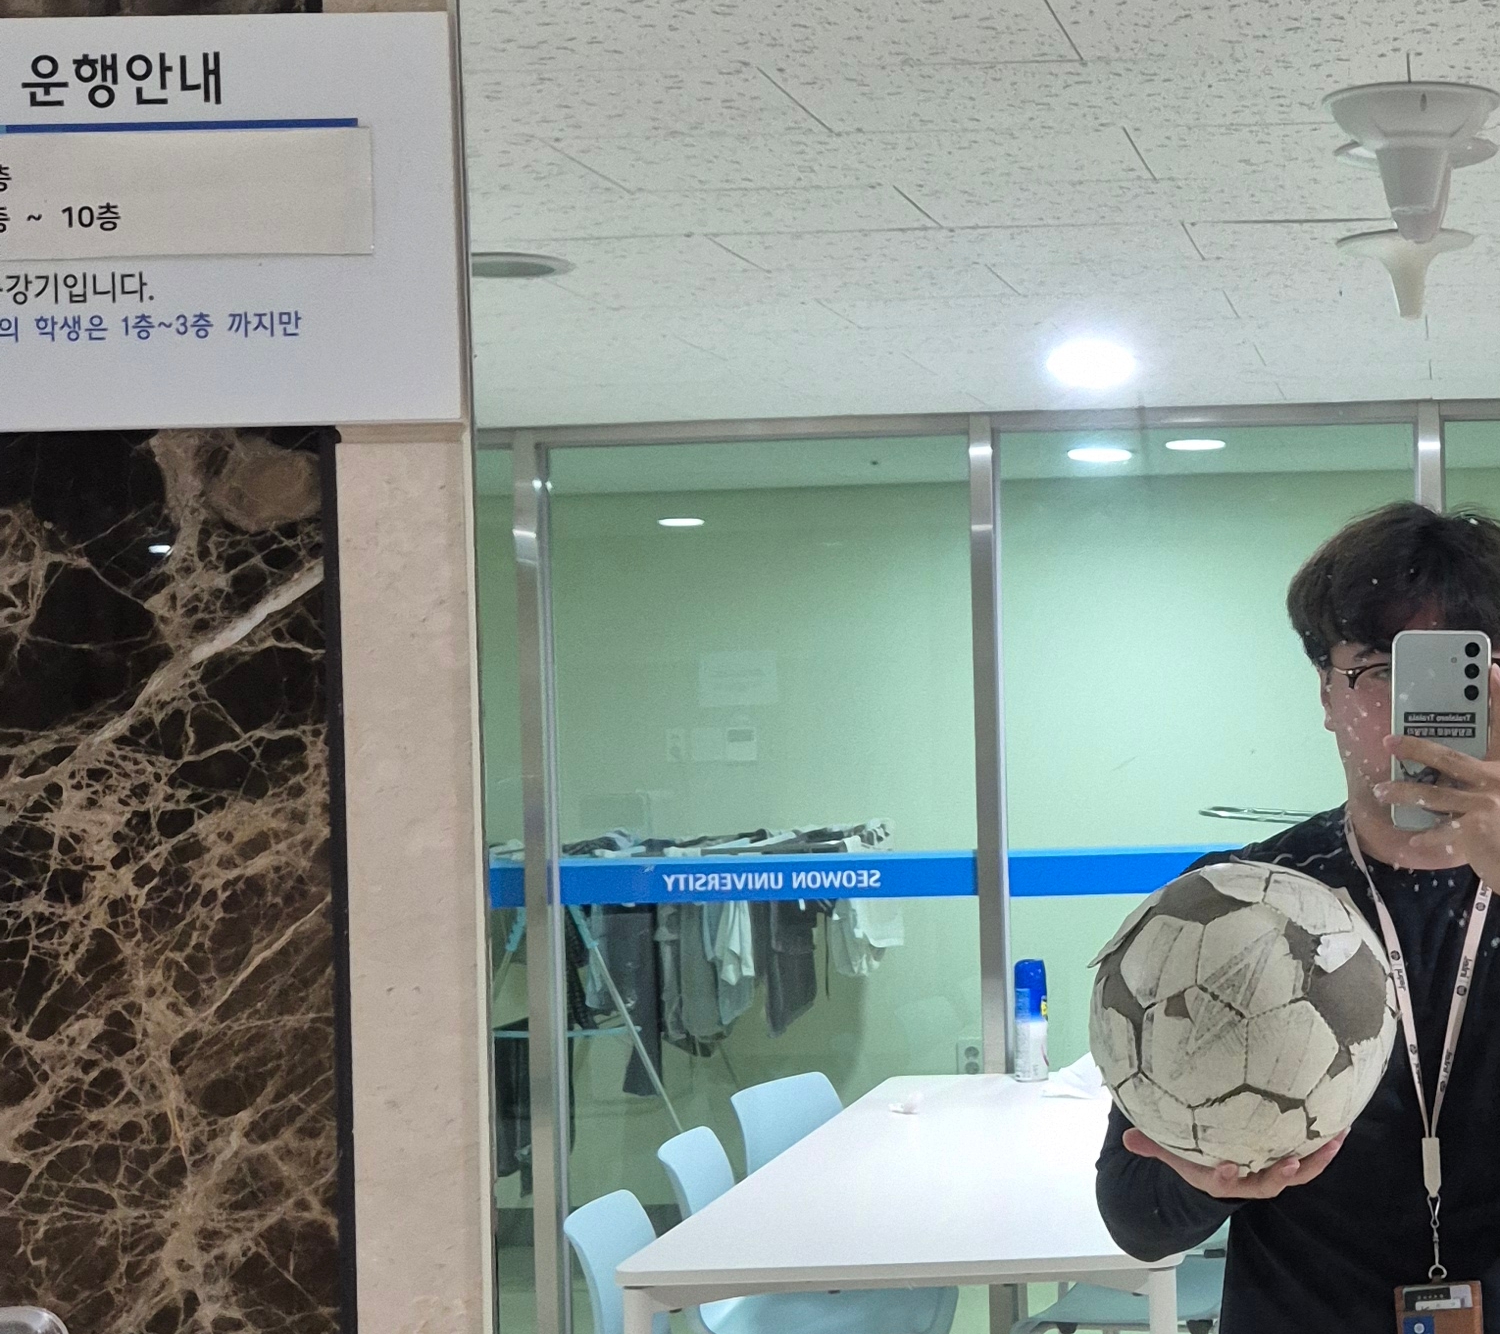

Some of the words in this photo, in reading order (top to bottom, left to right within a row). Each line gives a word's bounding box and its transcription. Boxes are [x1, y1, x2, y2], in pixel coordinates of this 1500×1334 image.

[21, 51, 223, 108] 운행안내
[61, 202, 121, 232] 10층
[0, 270, 155, 306] 강기입니다.
[34, 314, 109, 343] 학생은
[121, 312, 214, 341] 1층~3층
[227, 310, 302, 339] 까지만
